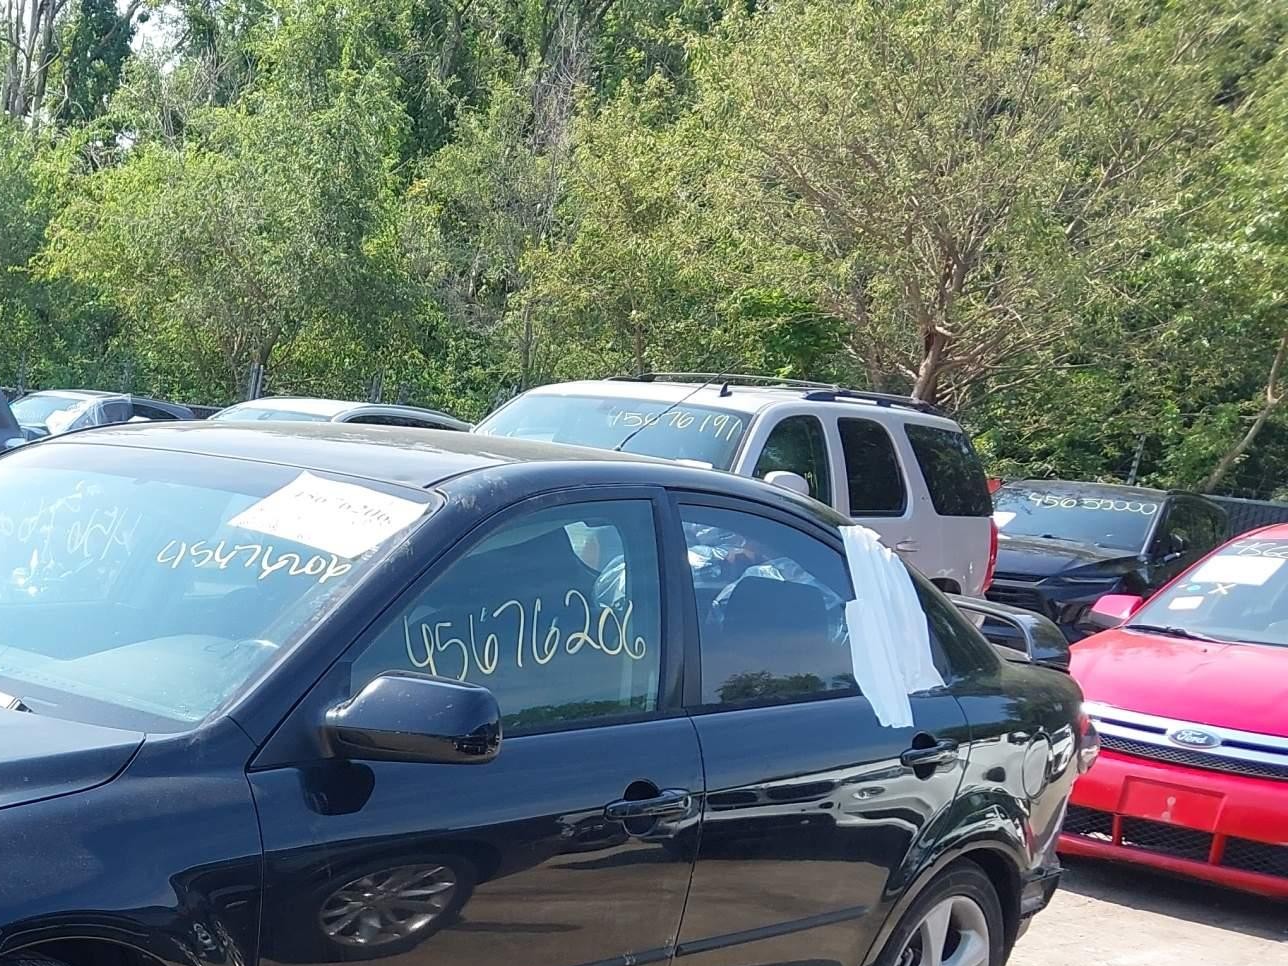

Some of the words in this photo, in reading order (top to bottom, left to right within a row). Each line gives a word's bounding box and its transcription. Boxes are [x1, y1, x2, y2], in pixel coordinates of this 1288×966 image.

[156, 540, 353, 584] 45676206
[403, 590, 646, 682] 45676206
[1176, 730, 1209, 744] Ford
